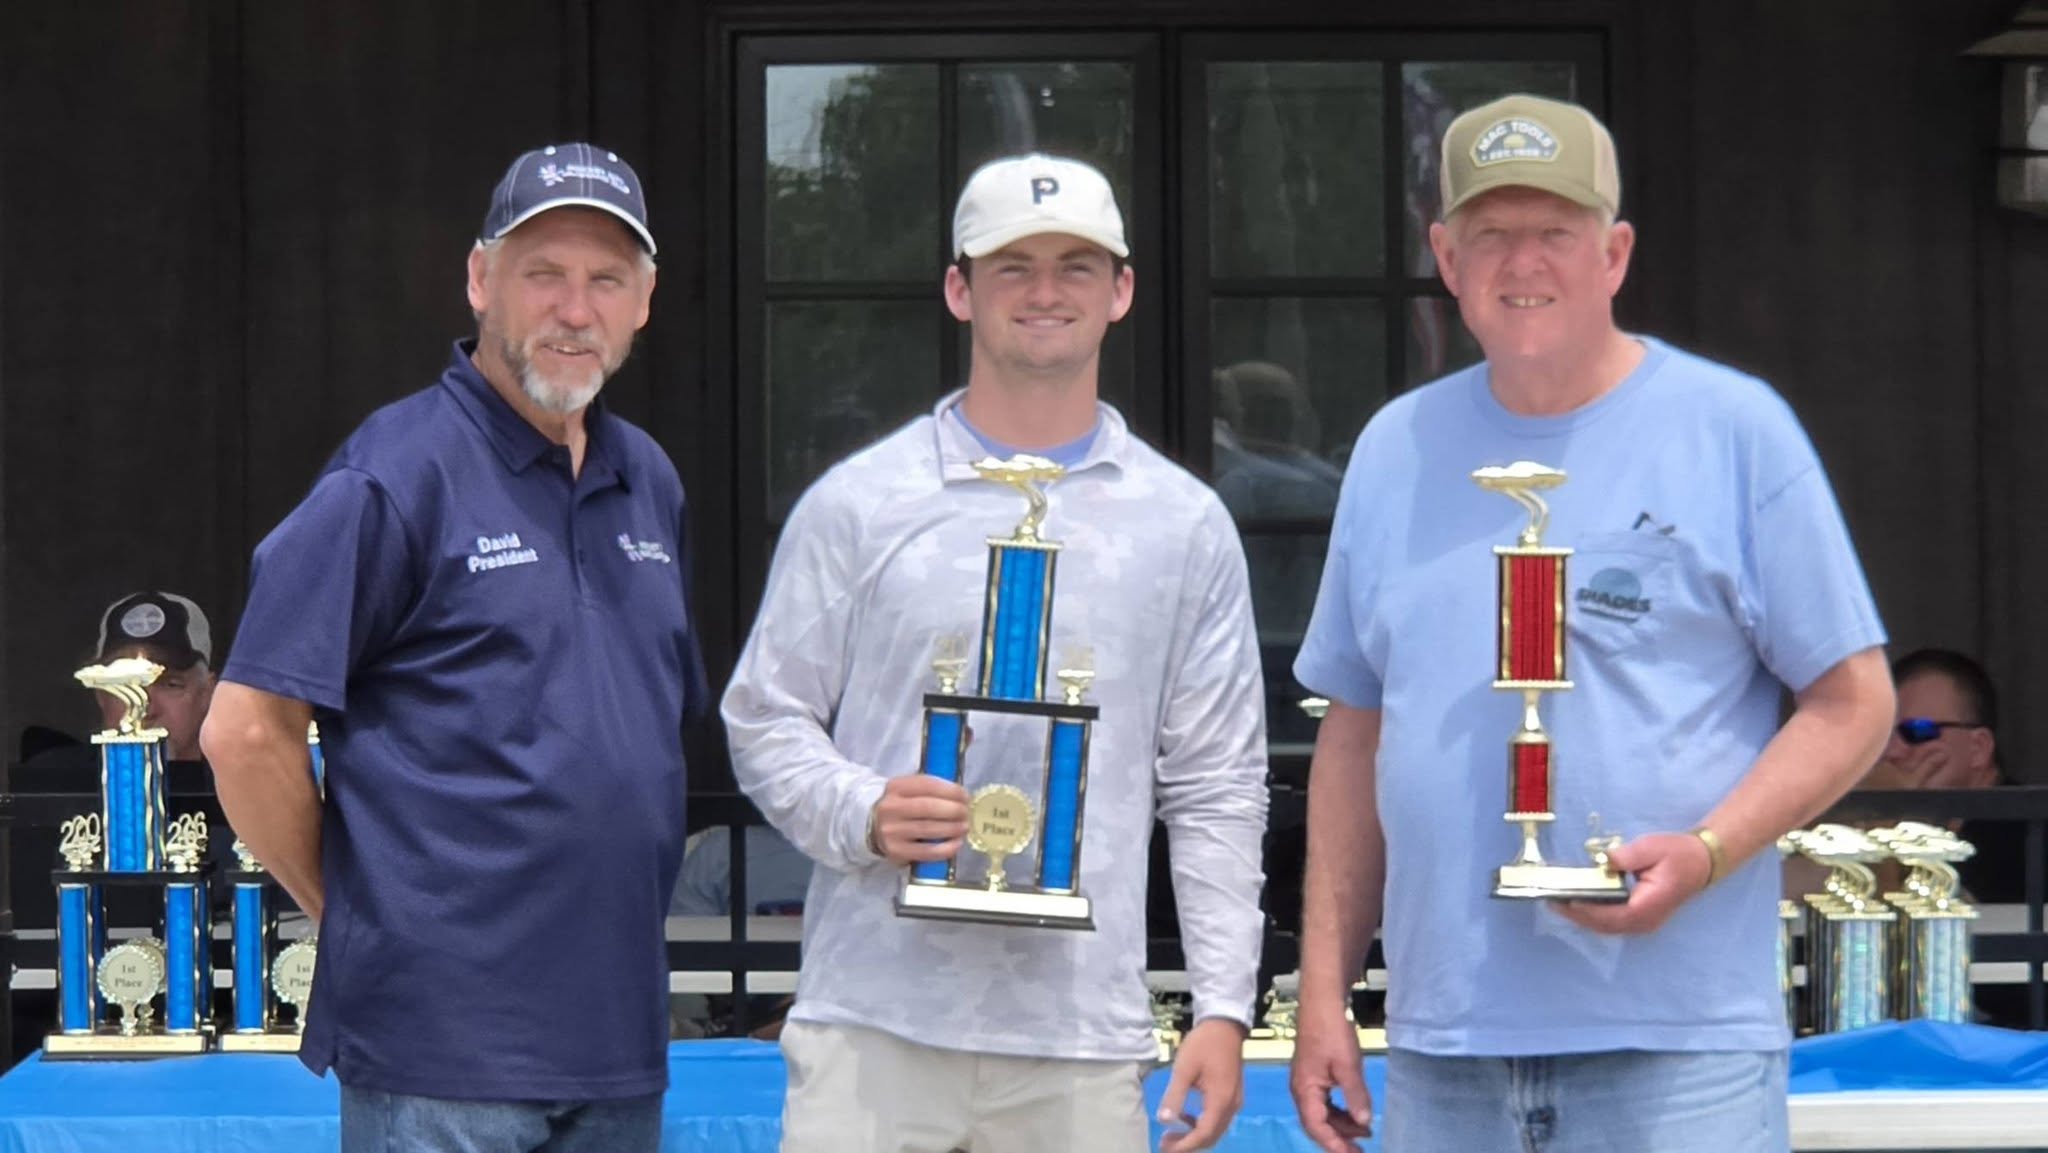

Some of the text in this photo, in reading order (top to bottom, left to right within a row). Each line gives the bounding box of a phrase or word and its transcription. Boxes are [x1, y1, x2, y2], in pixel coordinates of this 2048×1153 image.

[1477, 121, 1553, 151] MAC TOOLS
[1031, 177, 1060, 206] P
[477, 532, 521, 554] David
[467, 547, 539, 573] President
[1576, 587, 1651, 613] SHADES
[992, 806, 1009, 819] 1st
[982, 821, 1015, 837] Place
[122, 963, 137, 974] 1st
[114, 976, 143, 988] Place
